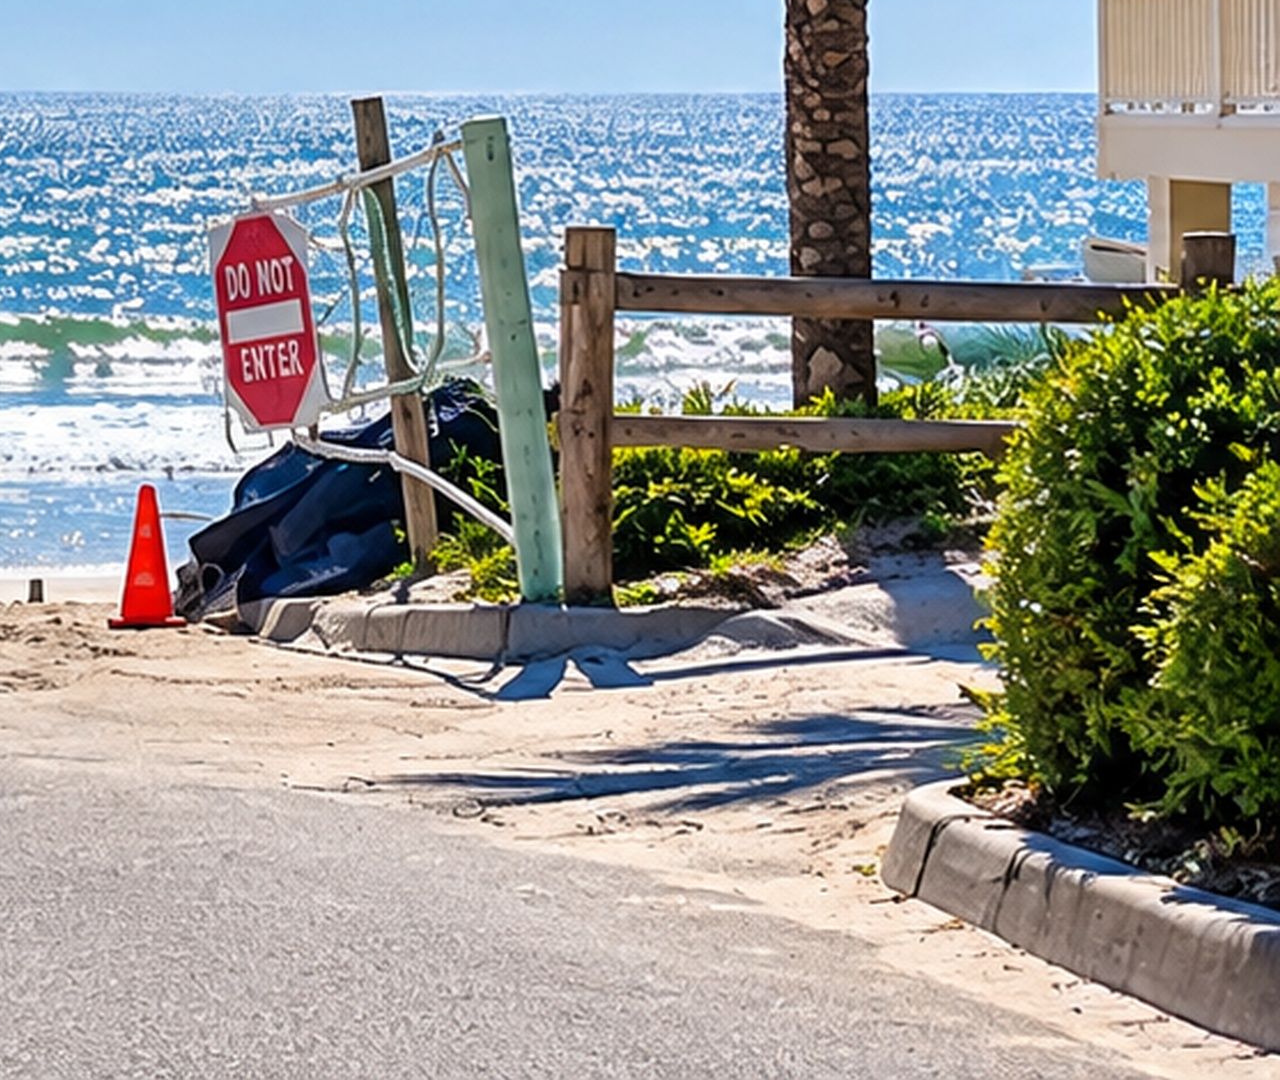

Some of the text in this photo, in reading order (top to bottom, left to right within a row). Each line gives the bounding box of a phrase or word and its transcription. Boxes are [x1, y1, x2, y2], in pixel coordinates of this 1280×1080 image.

[224, 255, 294, 302] DO NOT
[240, 339, 305, 384] ENTER
